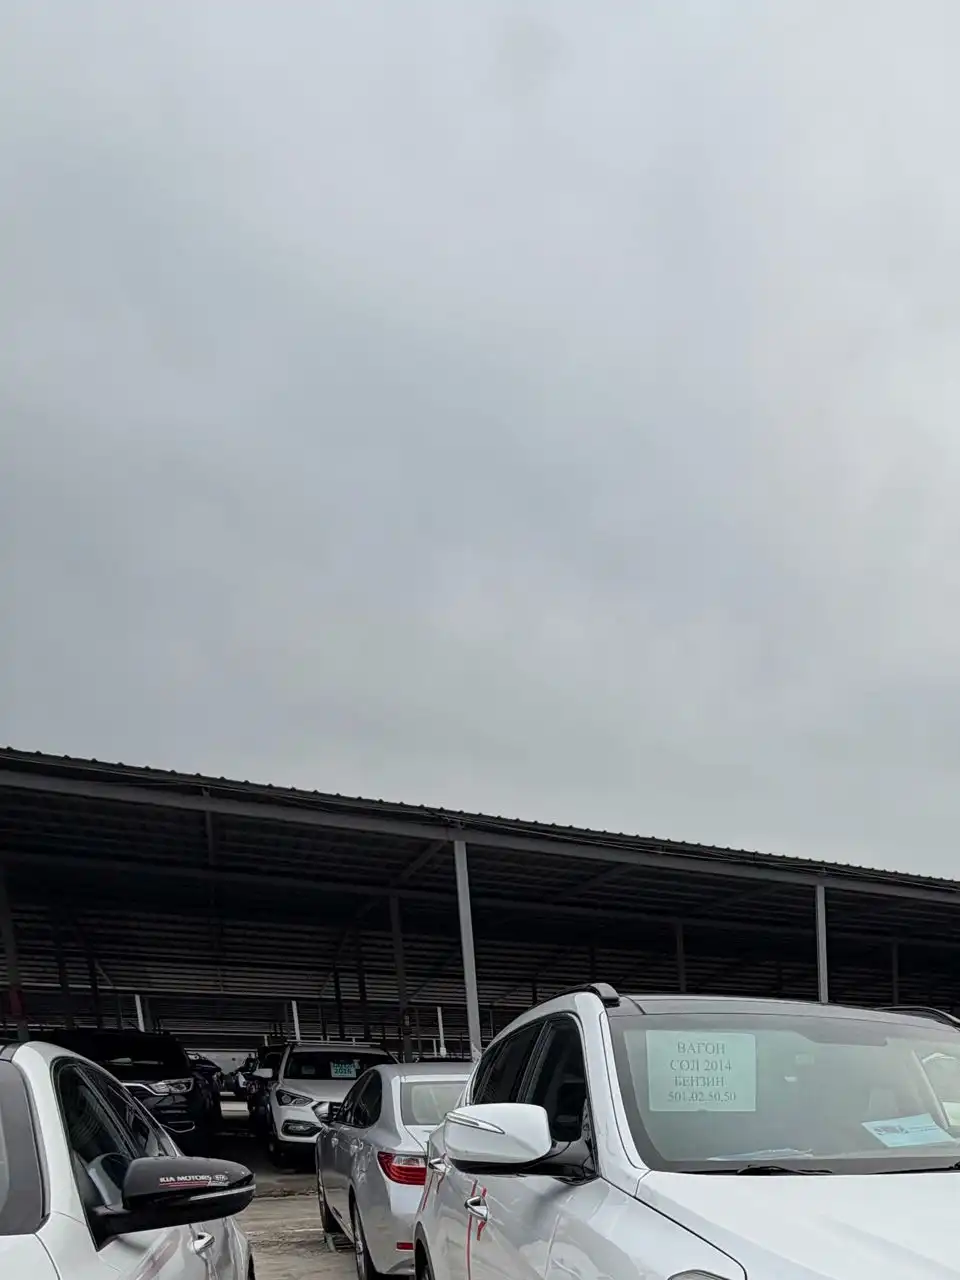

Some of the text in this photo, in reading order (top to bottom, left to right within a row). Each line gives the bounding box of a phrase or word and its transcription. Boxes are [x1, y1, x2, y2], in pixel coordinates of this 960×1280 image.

[677, 1041, 725, 1055] ВАГОН
[704, 1059, 732, 1072] 2014
[674, 1076, 724, 1087] БЕНЗИН
[177, 1174, 212, 1182] MOTORS
